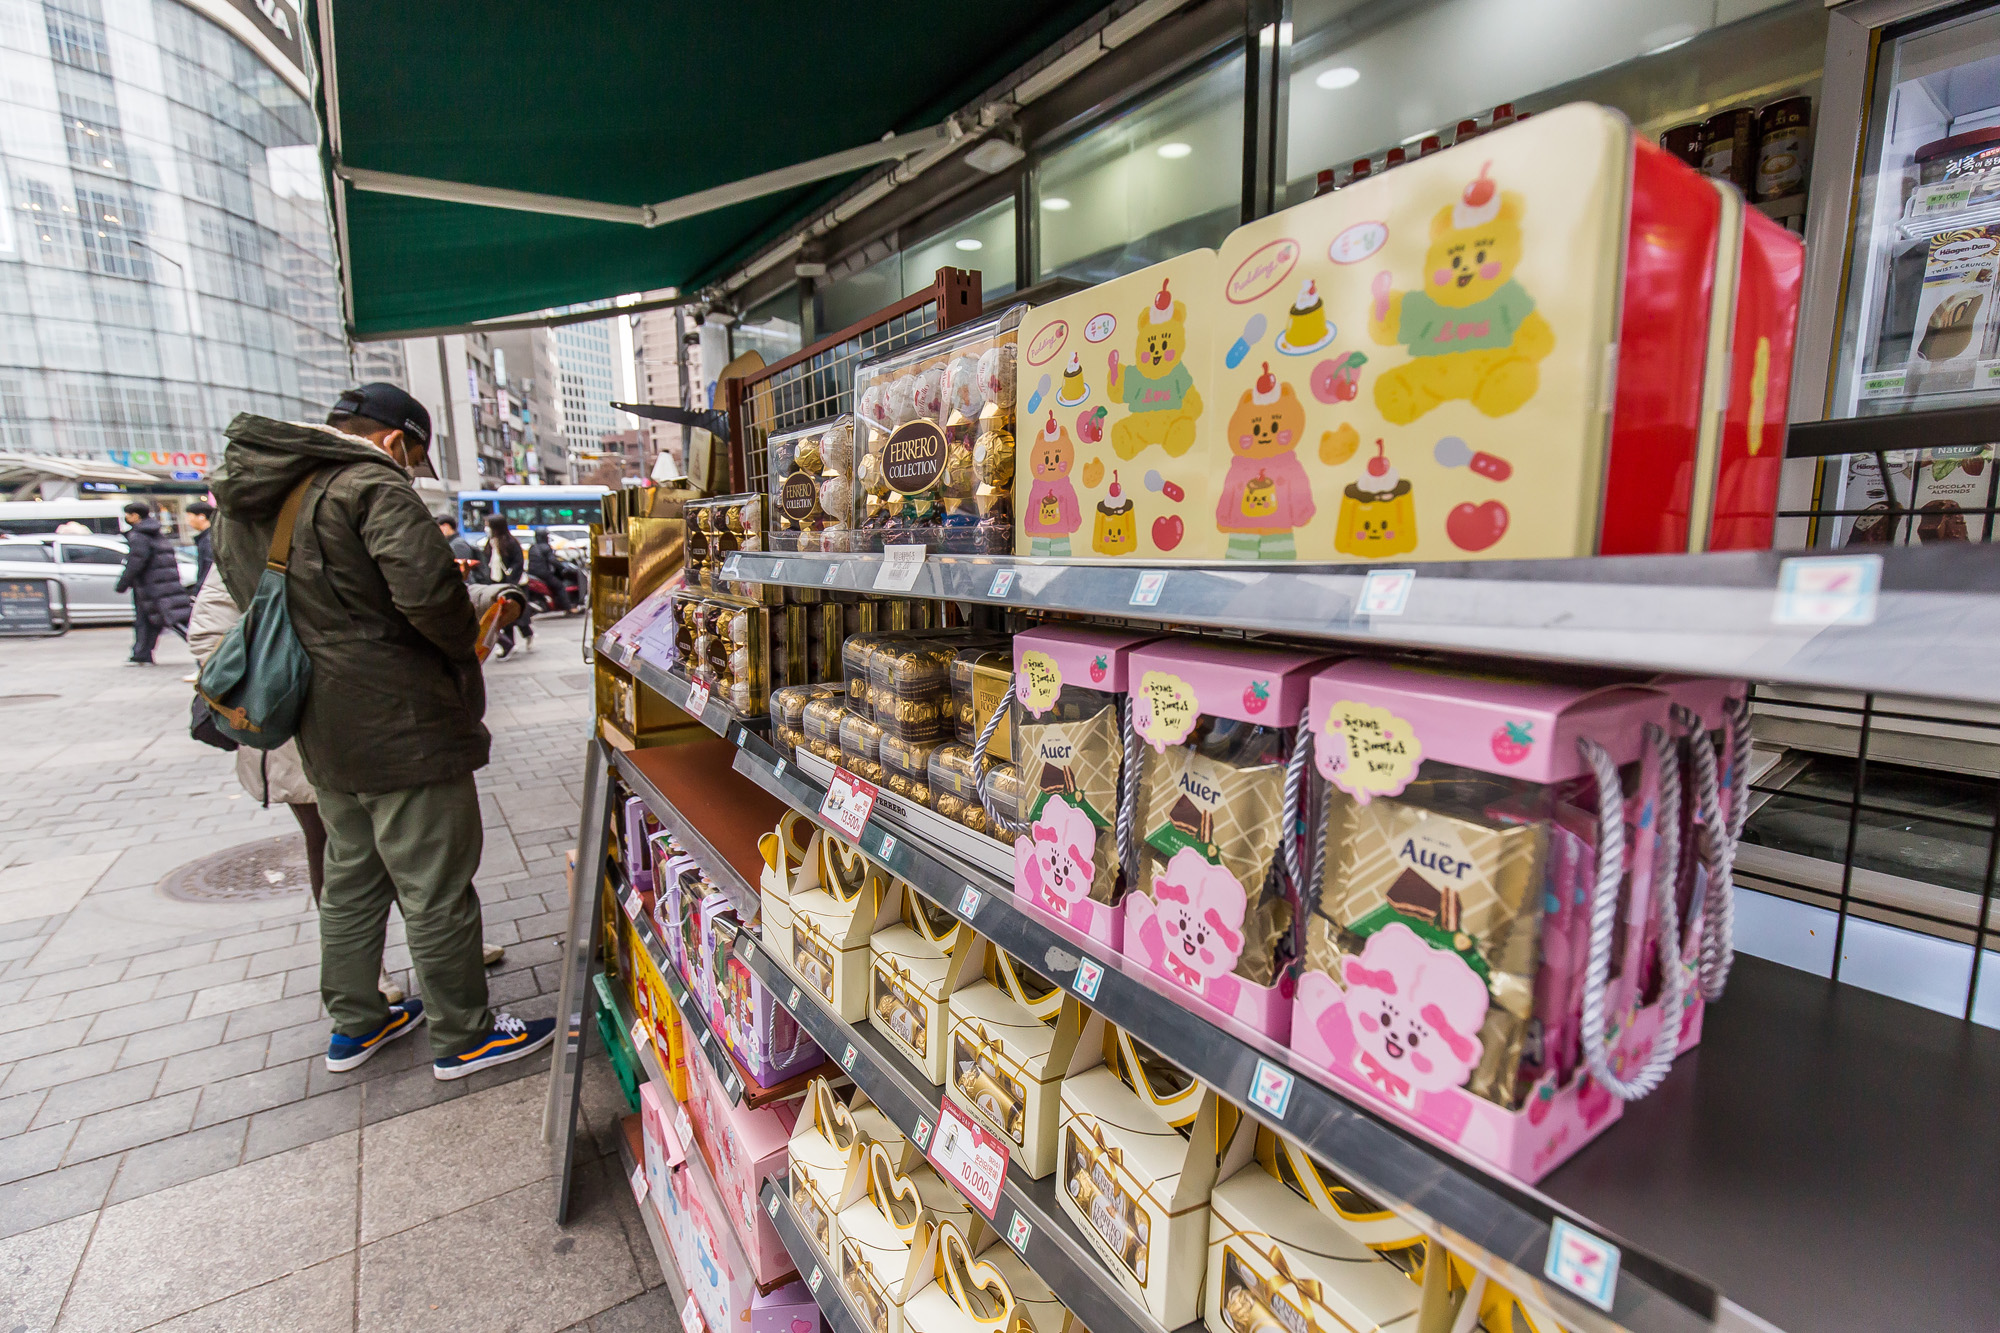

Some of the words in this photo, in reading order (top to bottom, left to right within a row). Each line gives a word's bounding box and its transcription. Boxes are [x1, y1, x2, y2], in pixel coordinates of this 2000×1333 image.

[1939, 244, 1991, 256] Häagen-Dazs
[1931, 266, 1953, 275] TWIST
[889, 435, 938, 463] FERRERO
[889, 459, 937, 479] COLLECTION
[786, 483, 812, 498] FERRERO
[786, 498, 812, 509] COLLECTION
[1040, 743, 1072, 759] Auer
[1178, 772, 1221, 805] Auer
[1399, 838, 1472, 879] Auer
[961, 1115, 971, 1127] DAY
[1094, 1202, 1121, 1241] FERRERO
[1096, 1240, 1126, 1282] CHOCOLATE
